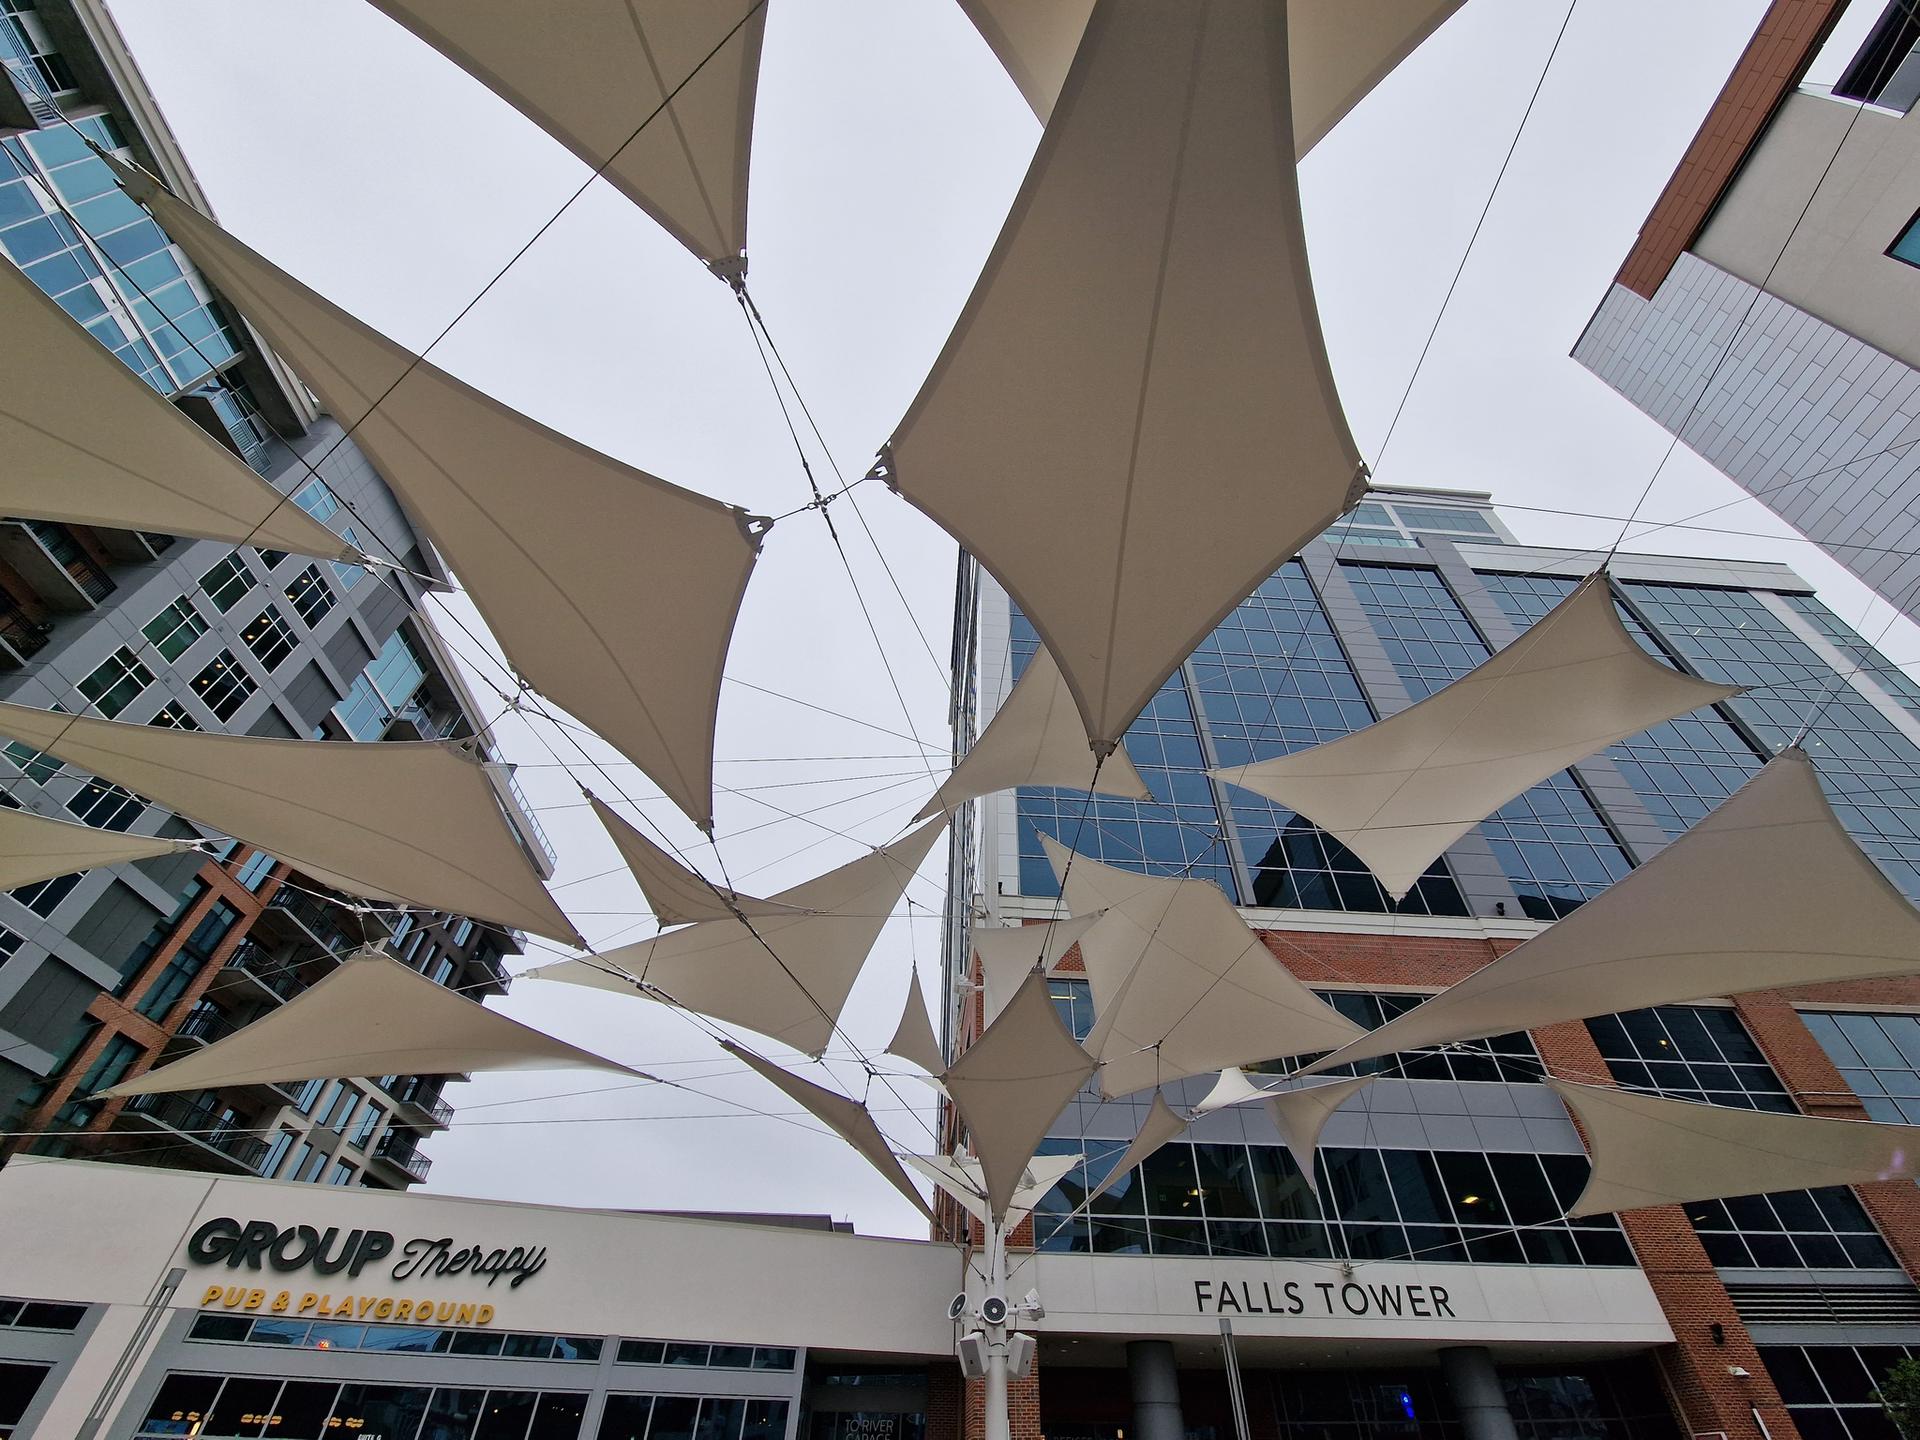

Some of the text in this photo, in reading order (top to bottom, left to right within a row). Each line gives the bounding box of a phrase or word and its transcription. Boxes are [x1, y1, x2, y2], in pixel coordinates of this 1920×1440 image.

[188, 1217, 547, 1289] GROUP Therapy
[202, 1285, 495, 1326] PUB & PLAYGROUND
[1194, 1280, 1456, 1318] FALLS TOWER
[845, 1419, 894, 1433] TO RIVER
